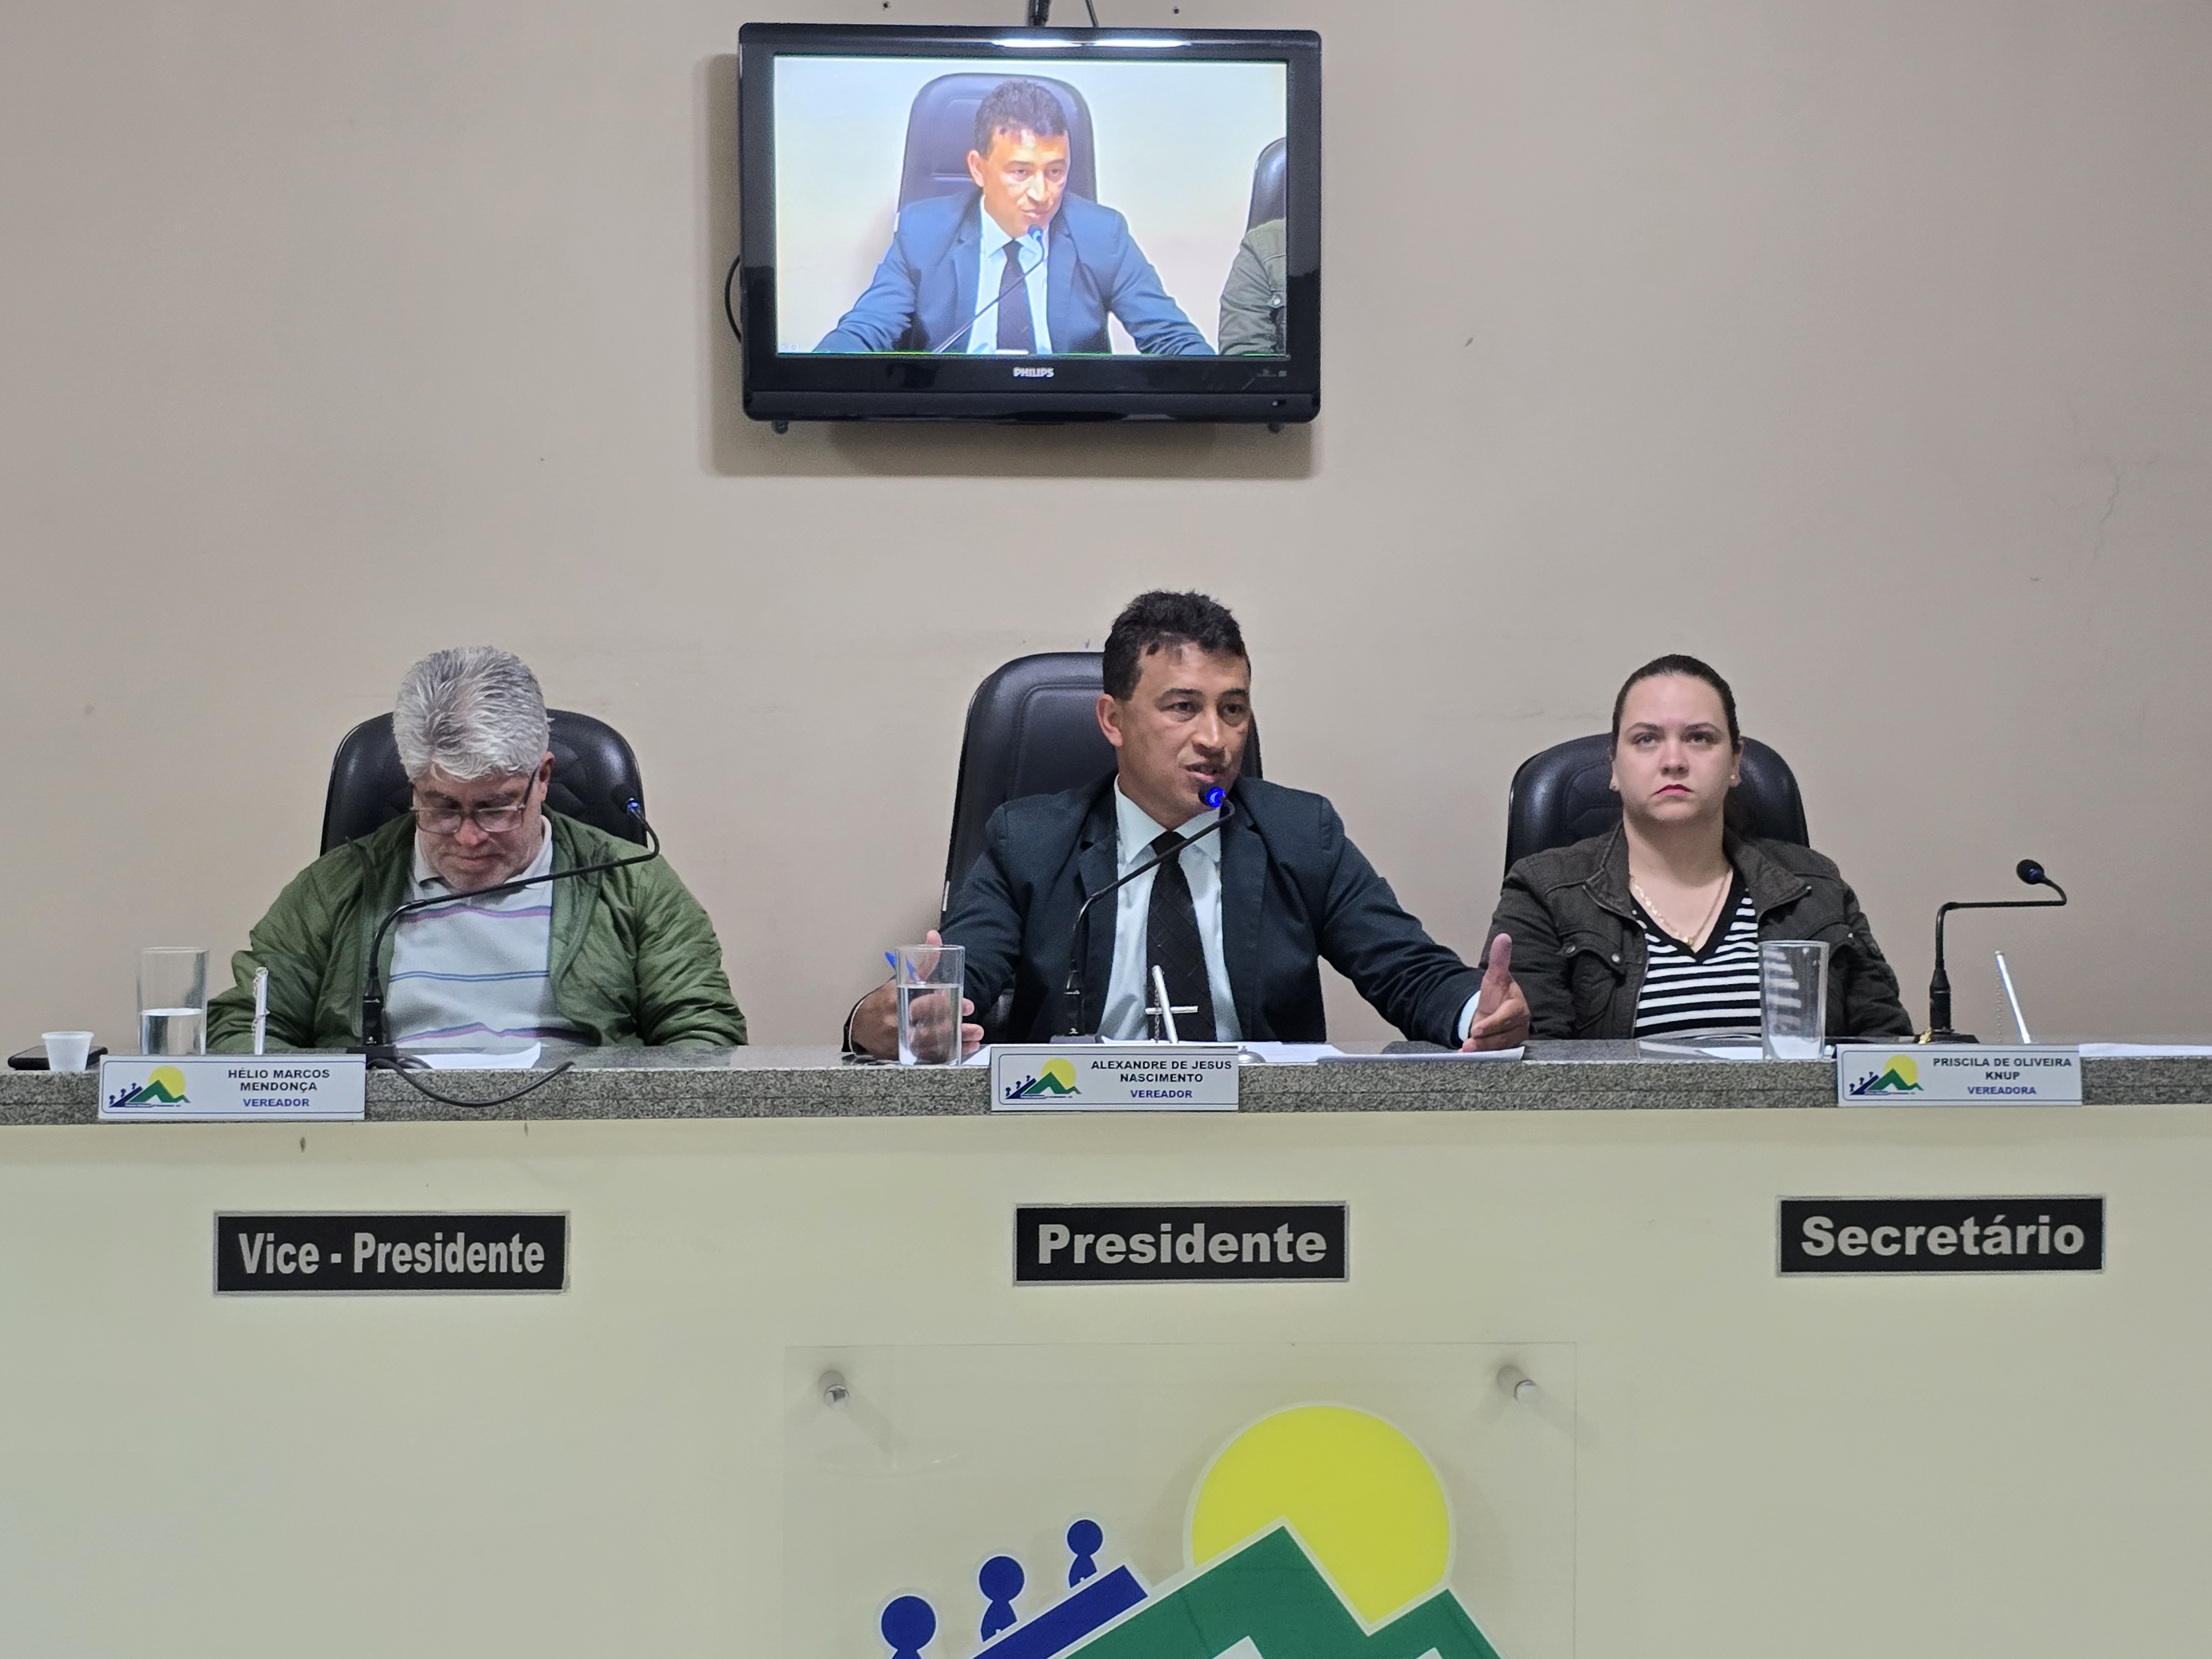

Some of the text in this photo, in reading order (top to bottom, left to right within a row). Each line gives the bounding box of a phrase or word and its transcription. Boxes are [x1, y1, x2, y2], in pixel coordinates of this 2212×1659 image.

[1013, 367, 1055, 377] PHILIPS
[1091, 1060, 1232, 1070] ALEXANDRE DE JESUS
[1933, 1058, 2072, 1067] PRISCILA DE OLIVEIRA
[228, 1067, 330, 1079] HÉLIO MARCOS
[1120, 1073, 1203, 1082] NASCIMENTO
[1985, 1072, 2020, 1080] KNUP
[240, 1082, 317, 1093] MENDONÇA
[1968, 1087, 2036, 1095] VEREADORA
[1130, 1090, 1193, 1098] VEREADOR
[243, 1098, 310, 1107] VEREADOR
[1801, 1215, 2085, 1256] Secretário
[1039, 1223, 1327, 1264] Presidente
[238, 1233, 320, 1274] Vice
[354, 1232, 545, 1274] Presidente
